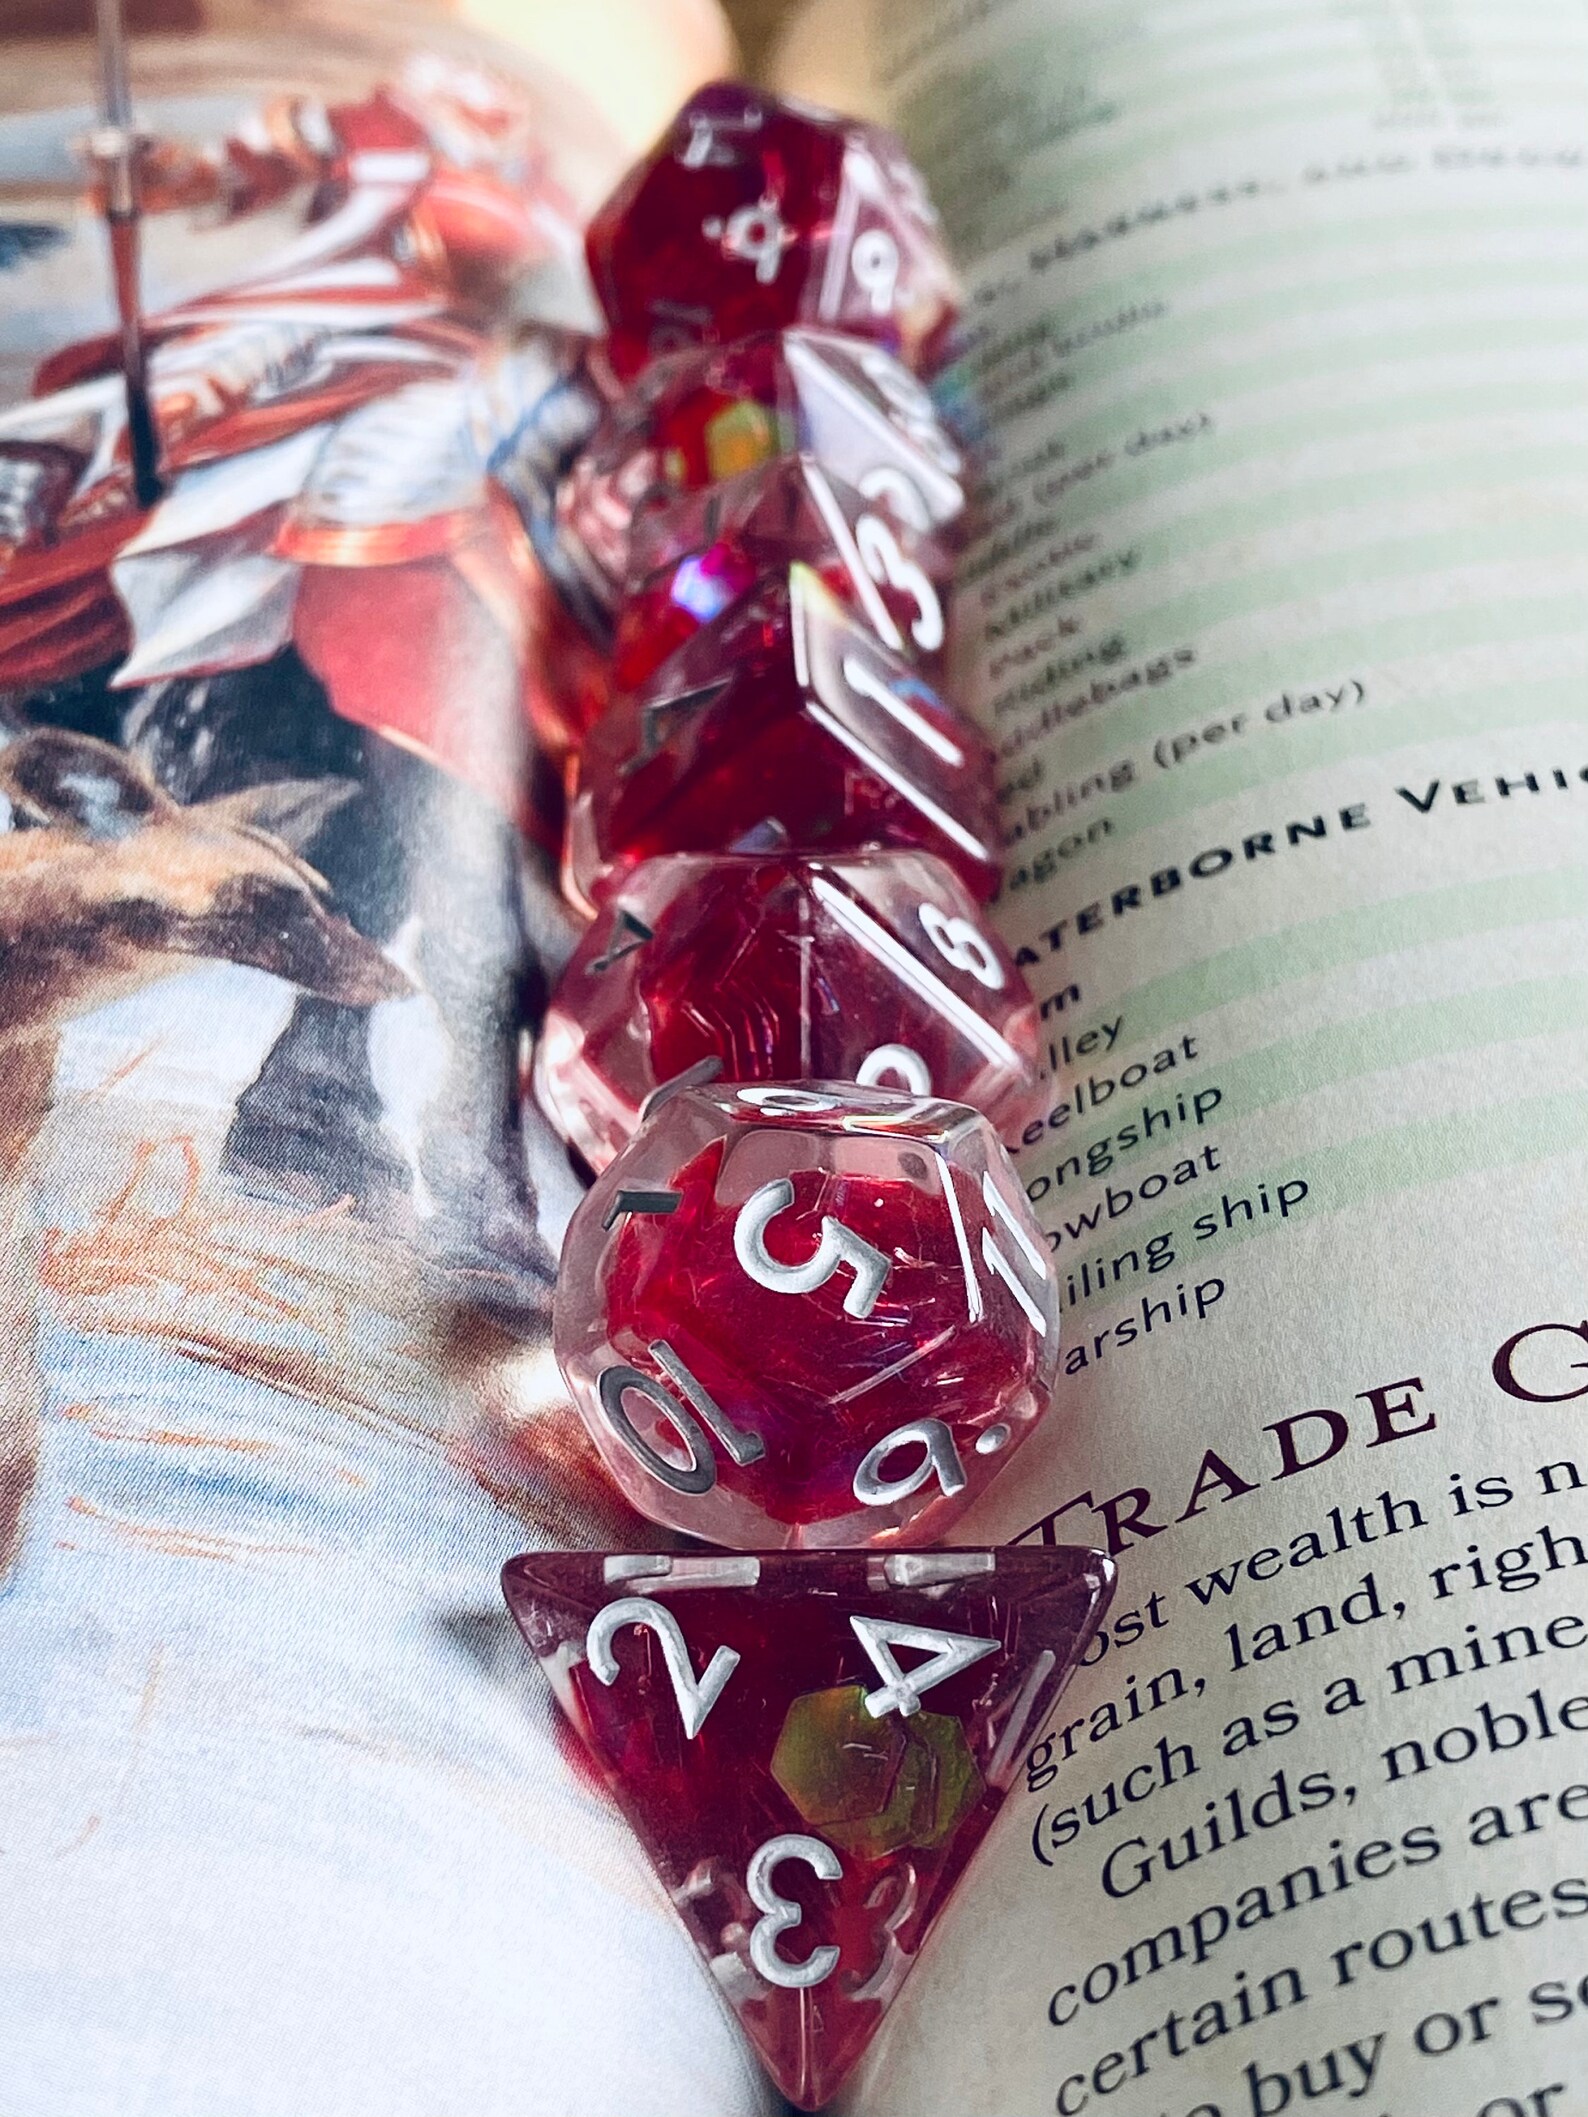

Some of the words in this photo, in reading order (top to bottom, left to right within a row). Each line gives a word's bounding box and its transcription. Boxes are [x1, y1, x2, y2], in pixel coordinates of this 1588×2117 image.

[1153, 714, 1247, 770] (per
[1265, 679, 1366, 728] day)
[918, 902, 1005, 990] 8
[1039, 1014, 1124, 1081] lley
[732, 1176, 892, 1319] 5
[1059, 1231, 1176, 1314] iling
[1193, 1178, 1310, 1241] ship
[1064, 1277, 1226, 1376] arship
[1184, 1490, 1429, 1606] wealth
[1450, 1472, 1514, 1518] is
[585, 1596, 741, 1740] 2
[849, 1614, 1003, 1718] 4
[1025, 1674, 1207, 1793] grain,
[1227, 1572, 1408, 1672] land,
[1032, 1735, 1202, 1867] (such
[1222, 1698, 1301, 1757] as
[1324, 1677, 1366, 1716] a
[1386, 1615, 1588, 1695] mine
[1101, 1769, 1357, 1899] Guilds,
[746, 1832, 844, 1989] 3
[1047, 1823, 1443, 2027] companies
[1055, 1965, 1308, 2117] certain
[1331, 1876, 1588, 1988] routes
[1243, 2031, 1387, 2117] buy
[1413, 1994, 1501, 2058] or
